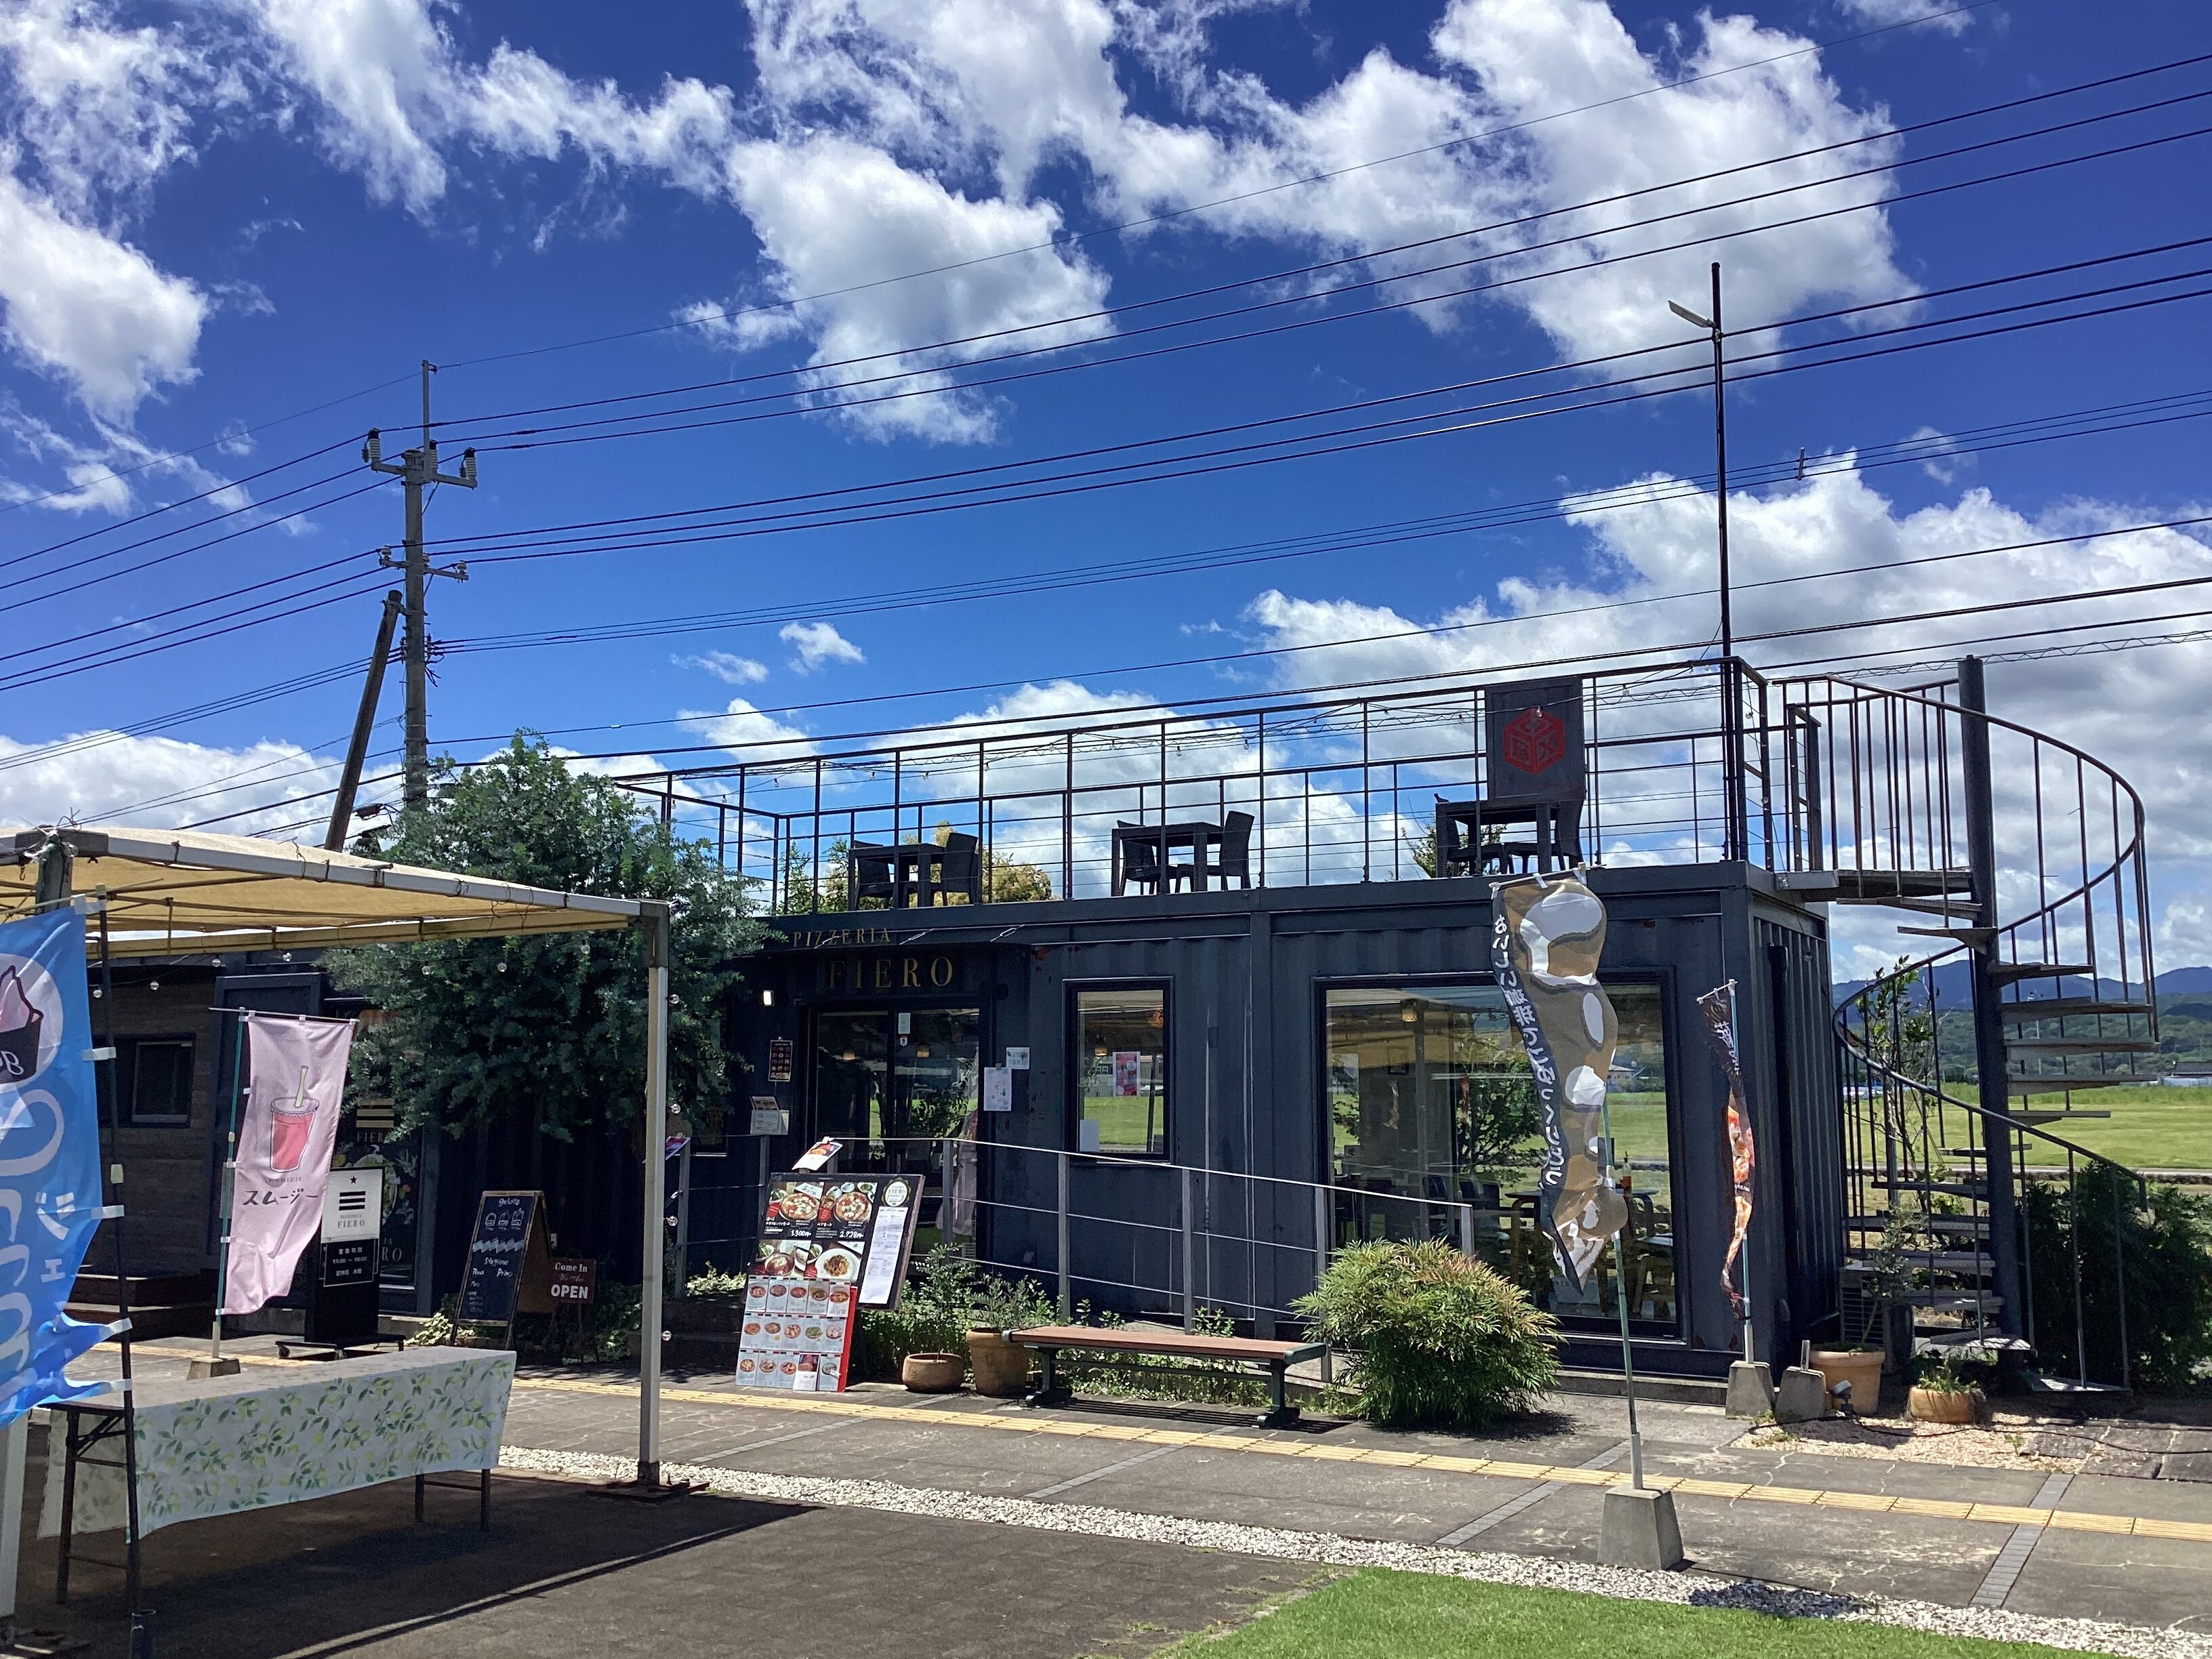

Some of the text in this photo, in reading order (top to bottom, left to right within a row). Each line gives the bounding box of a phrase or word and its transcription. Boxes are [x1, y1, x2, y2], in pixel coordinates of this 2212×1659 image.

[794, 927, 890, 947] PIZZERIA
[829, 956, 953, 989] FIERO
[243, 1188, 319, 1205] スムージー
[337, 1220, 365, 1229] FIERO
[555, 1262, 588, 1273] Come In
[551, 1284, 589, 1299] OPEN
